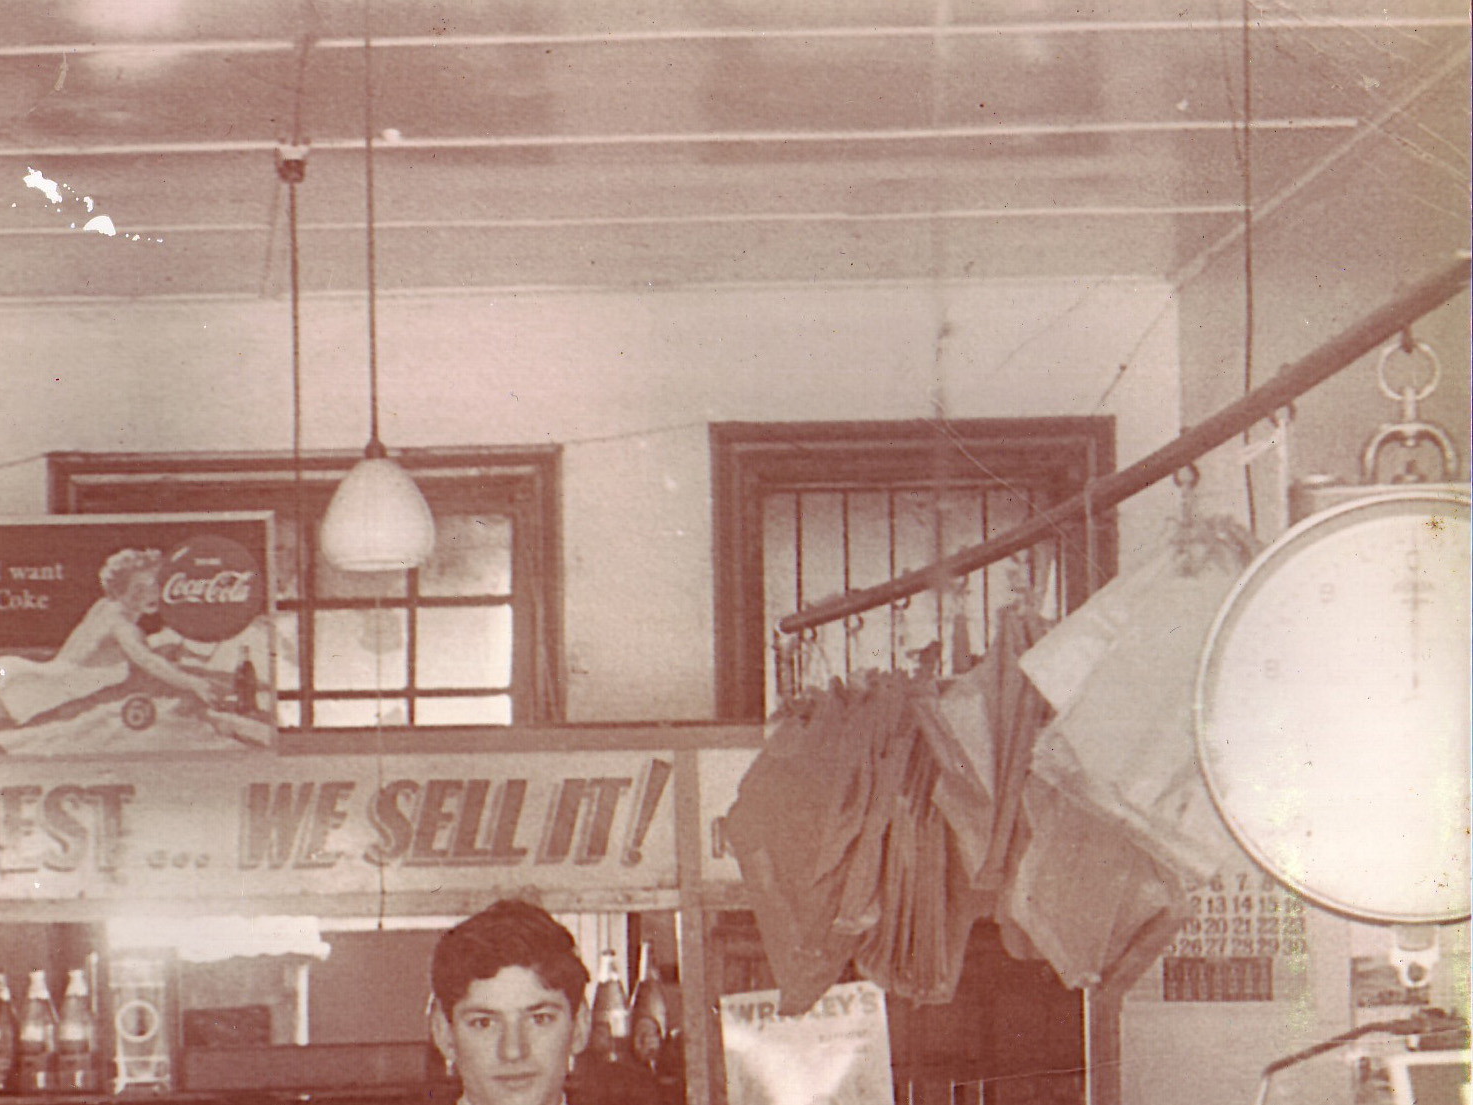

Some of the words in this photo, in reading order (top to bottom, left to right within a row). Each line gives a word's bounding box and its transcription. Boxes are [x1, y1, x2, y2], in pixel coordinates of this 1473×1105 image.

[9, 562, 64, 581] want
[238, 781, 355, 870] WE
[363, 778, 528, 868] SELL
[535, 758, 673, 869] IT!
[1210, 873, 1224, 892] 6
[1236, 873, 1248, 892] 7
[1207, 896, 1226, 914] 13
[1234, 896, 1252, 914] 14
[1259, 896, 1279, 914] 15
[1205, 917, 1228, 935] 20
[1233, 917, 1252, 935] 21
[1257, 917, 1280, 935] 22
[1283, 917, 1306, 935] 23
[1179, 937, 1203, 954] 26
[1206, 938, 1228, 955] 27
[1232, 938, 1255, 955] 28
[1257, 938, 1280, 956] 29
[727, 985, 878, 1024] WREY'S
